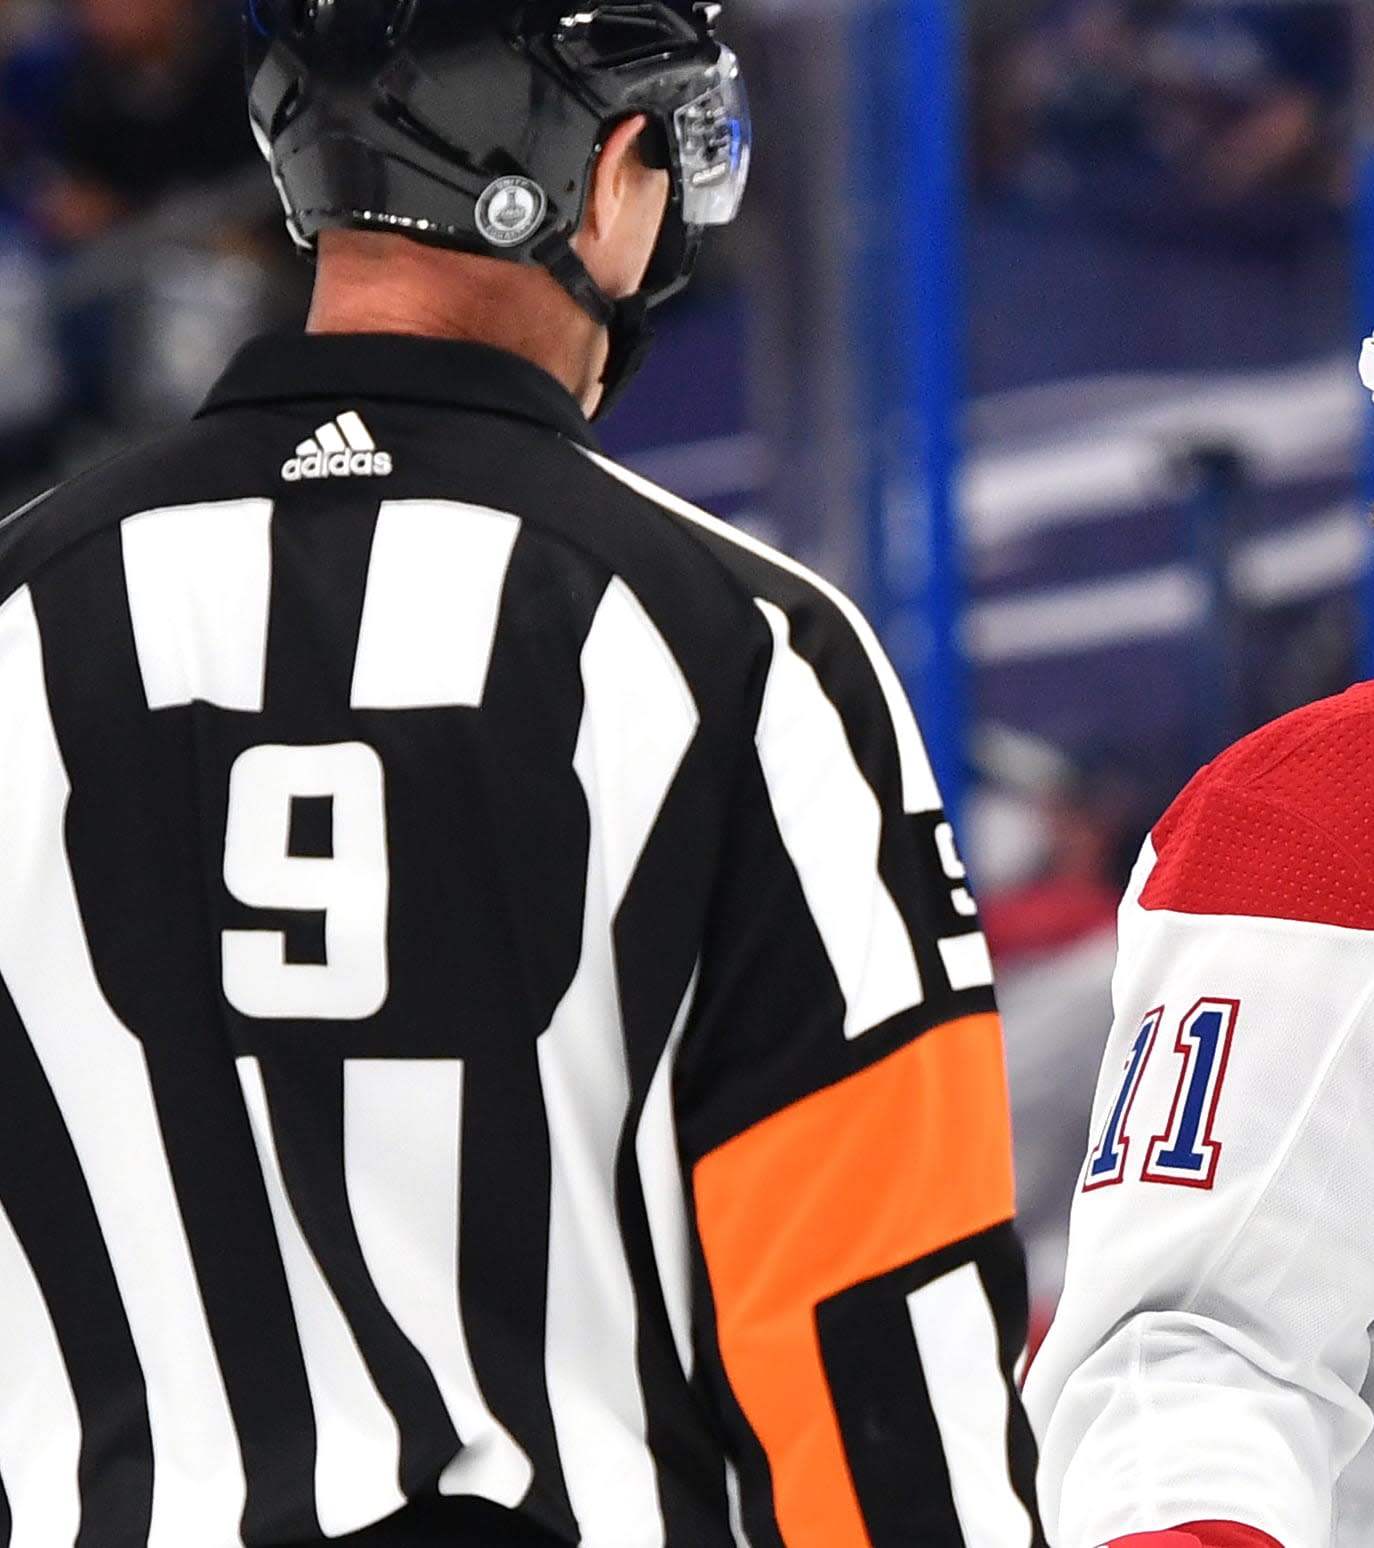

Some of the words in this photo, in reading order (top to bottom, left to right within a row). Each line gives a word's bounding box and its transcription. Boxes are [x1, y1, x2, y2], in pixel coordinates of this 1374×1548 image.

[281, 447, 393, 482] adidas
[221, 741, 389, 1020] 9
[1081, 996, 1241, 1193] 11
